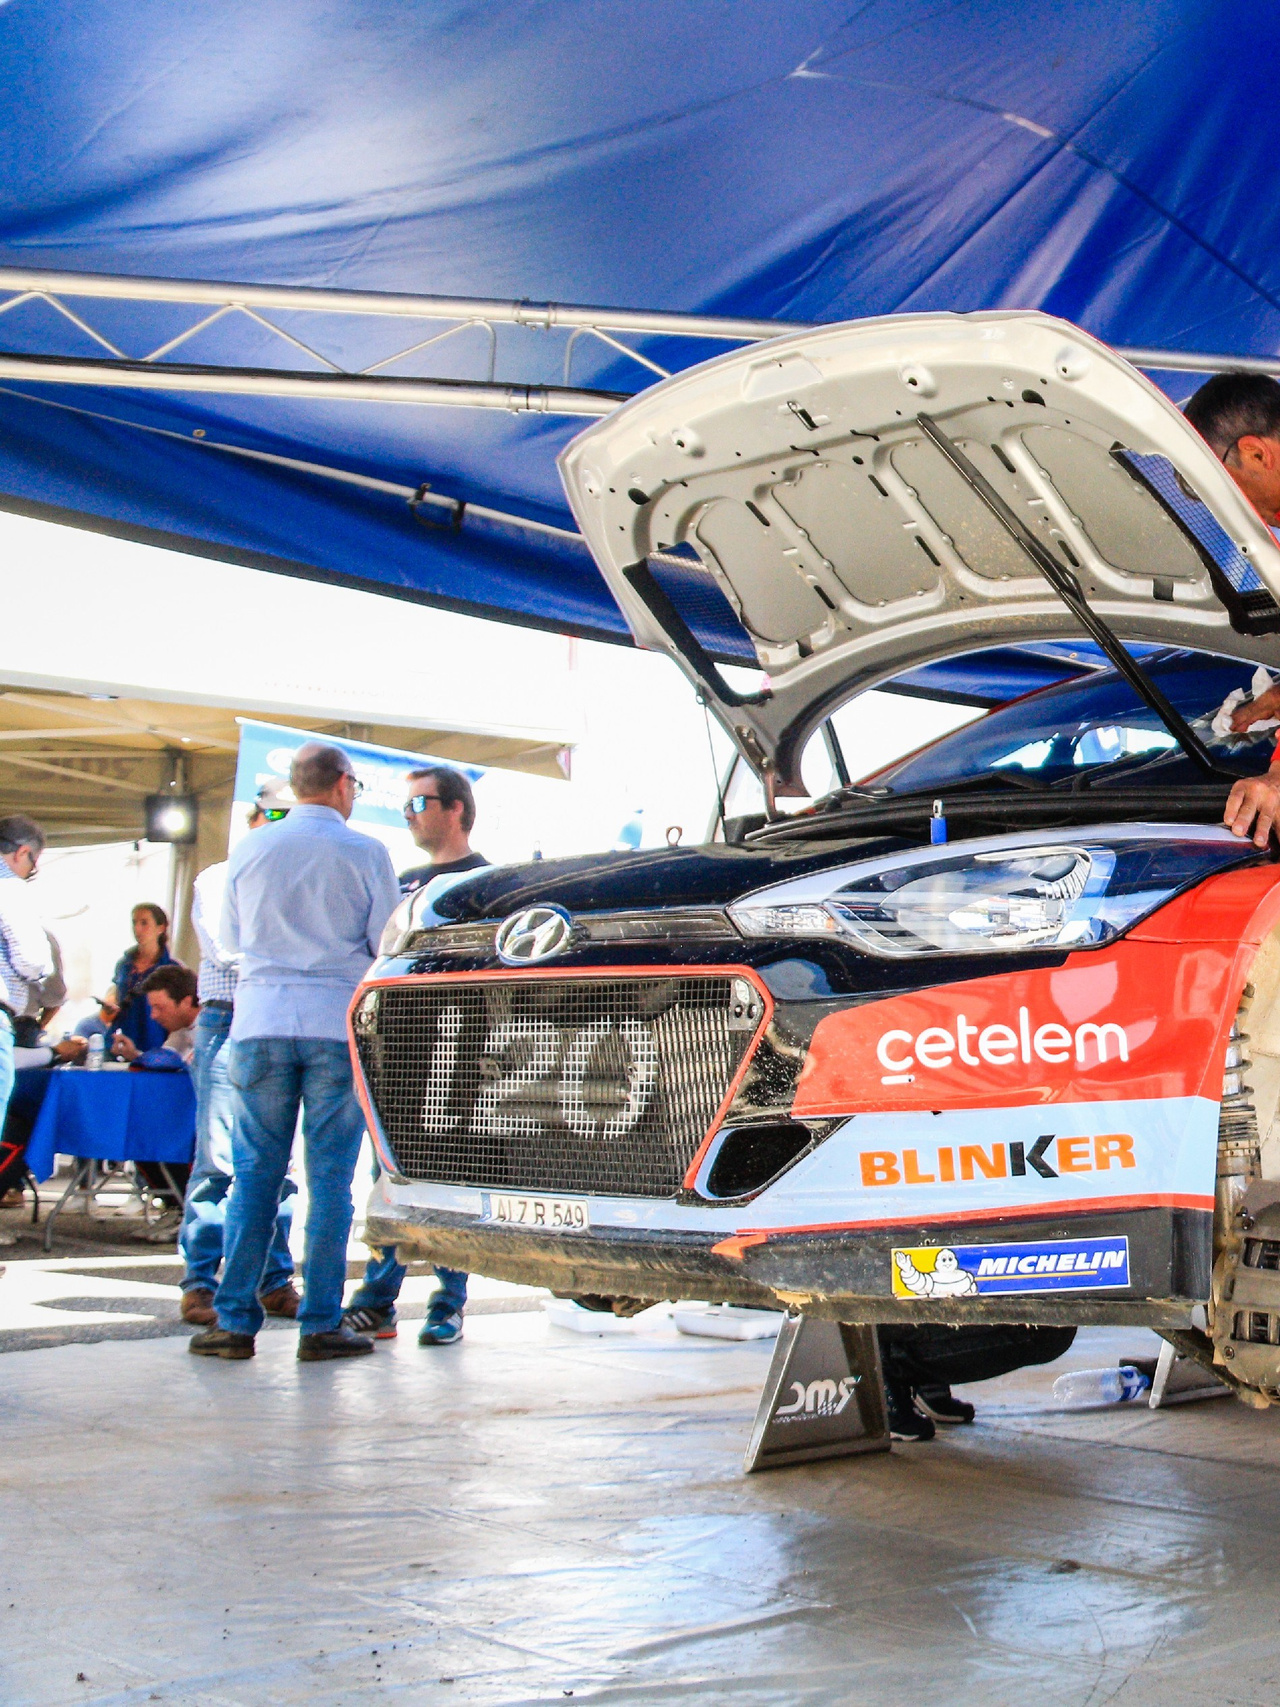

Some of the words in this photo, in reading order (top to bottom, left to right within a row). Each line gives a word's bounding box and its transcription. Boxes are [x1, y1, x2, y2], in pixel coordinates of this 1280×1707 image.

[877, 1006, 1129, 1085] cetelem
[859, 1134, 1136, 1187] BLINKER
[533, 1201, 546, 1226] R
[551, 1203, 585, 1229] 549
[977, 1250, 1126, 1275] MICHELIN
